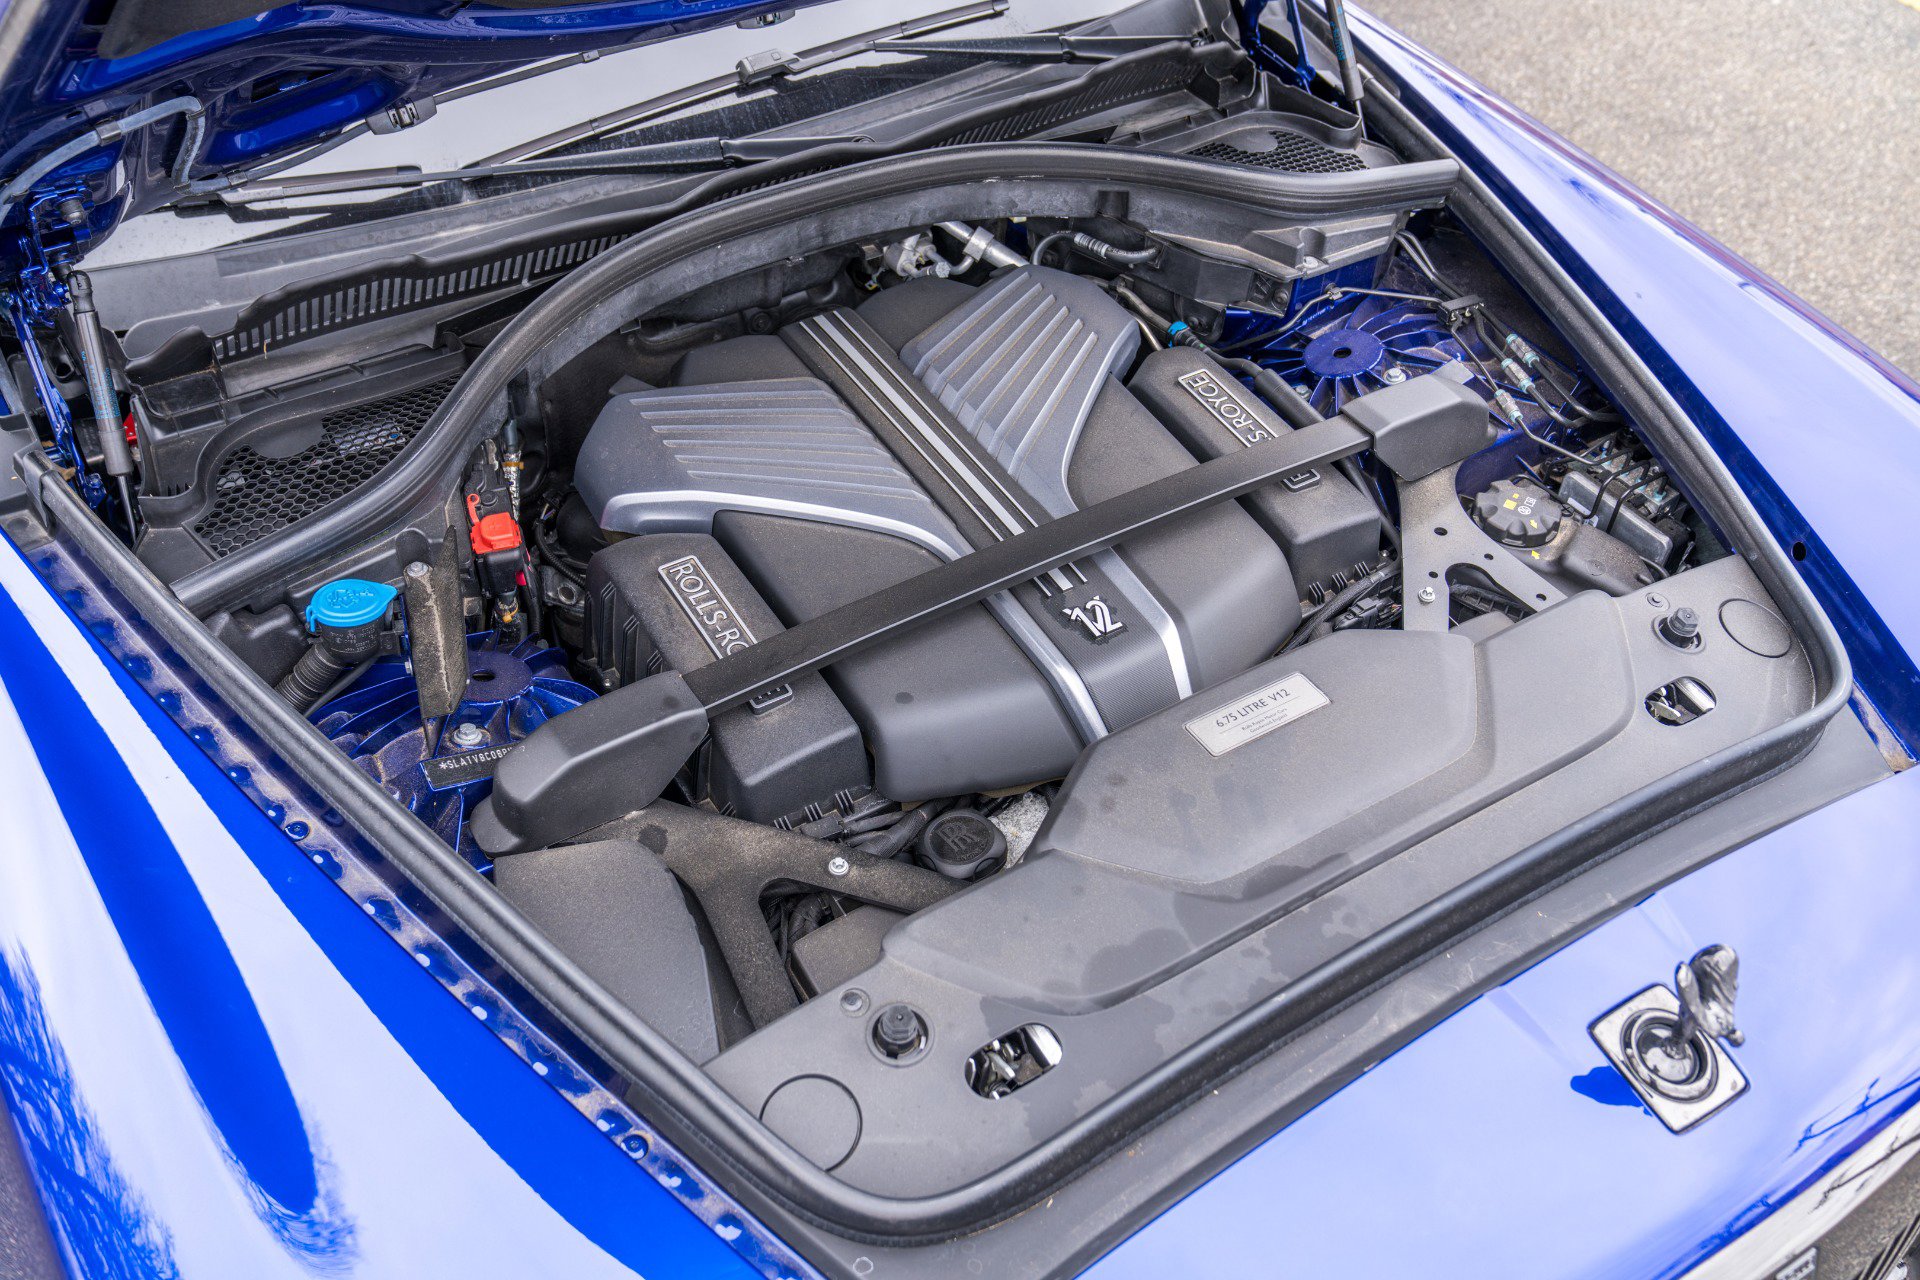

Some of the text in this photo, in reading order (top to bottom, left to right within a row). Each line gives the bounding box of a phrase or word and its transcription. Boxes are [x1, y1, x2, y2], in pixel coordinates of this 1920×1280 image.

[1216, 688, 1291, 727] 6.75 LITRE V12
